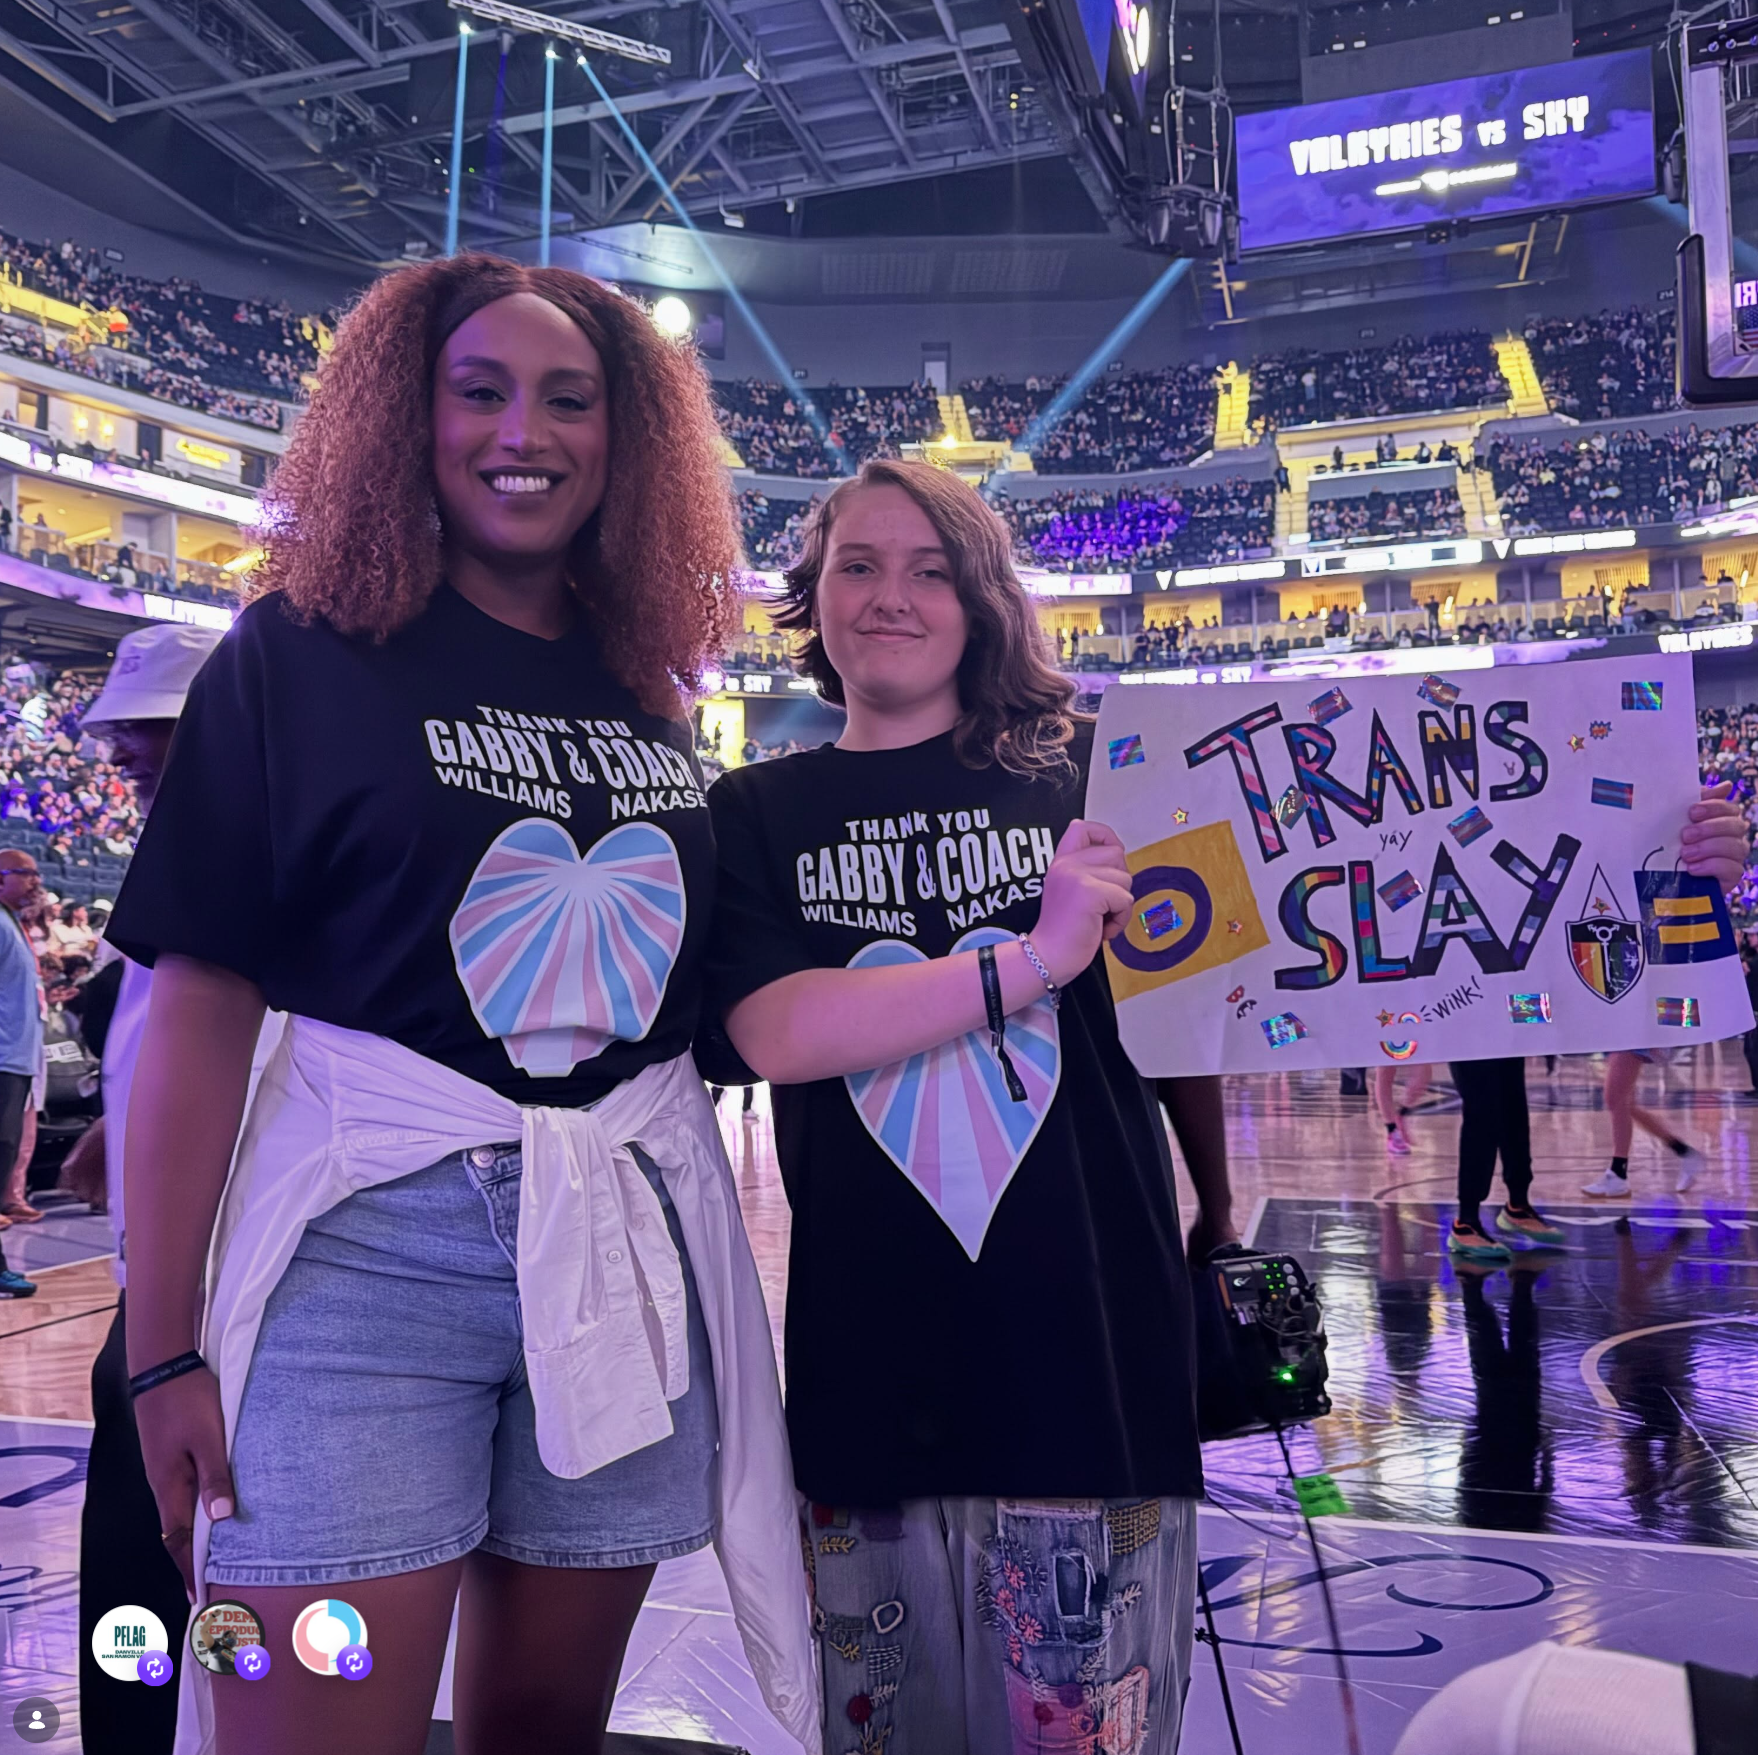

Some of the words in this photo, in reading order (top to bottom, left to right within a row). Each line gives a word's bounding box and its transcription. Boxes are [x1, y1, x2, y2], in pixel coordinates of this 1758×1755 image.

[1289, 114, 1462, 175] VALKYRIES
[1523, 96, 1589, 140] SKY
[424, 719, 561, 784] GABBY
[561, 739, 596, 784] &
[588, 737, 700, 790] COACH
[476, 704, 575, 734] THANK
[576, 719, 633, 738] YOU
[435, 765, 572, 819] WILLIAMS
[611, 790, 708, 820] NAKASE
[1183, 700, 1549, 863] TRANS
[845, 810, 930, 841] THANK
[936, 808, 991, 834] YOU
[796, 842, 906, 905] GABBY
[916, 843, 936, 900] &
[936, 827, 1055, 902] COACH
[801, 904, 917, 936] WILLIAMS
[946, 877, 1046, 931] NAKAS
[1275, 834, 1582, 990] SLAY
